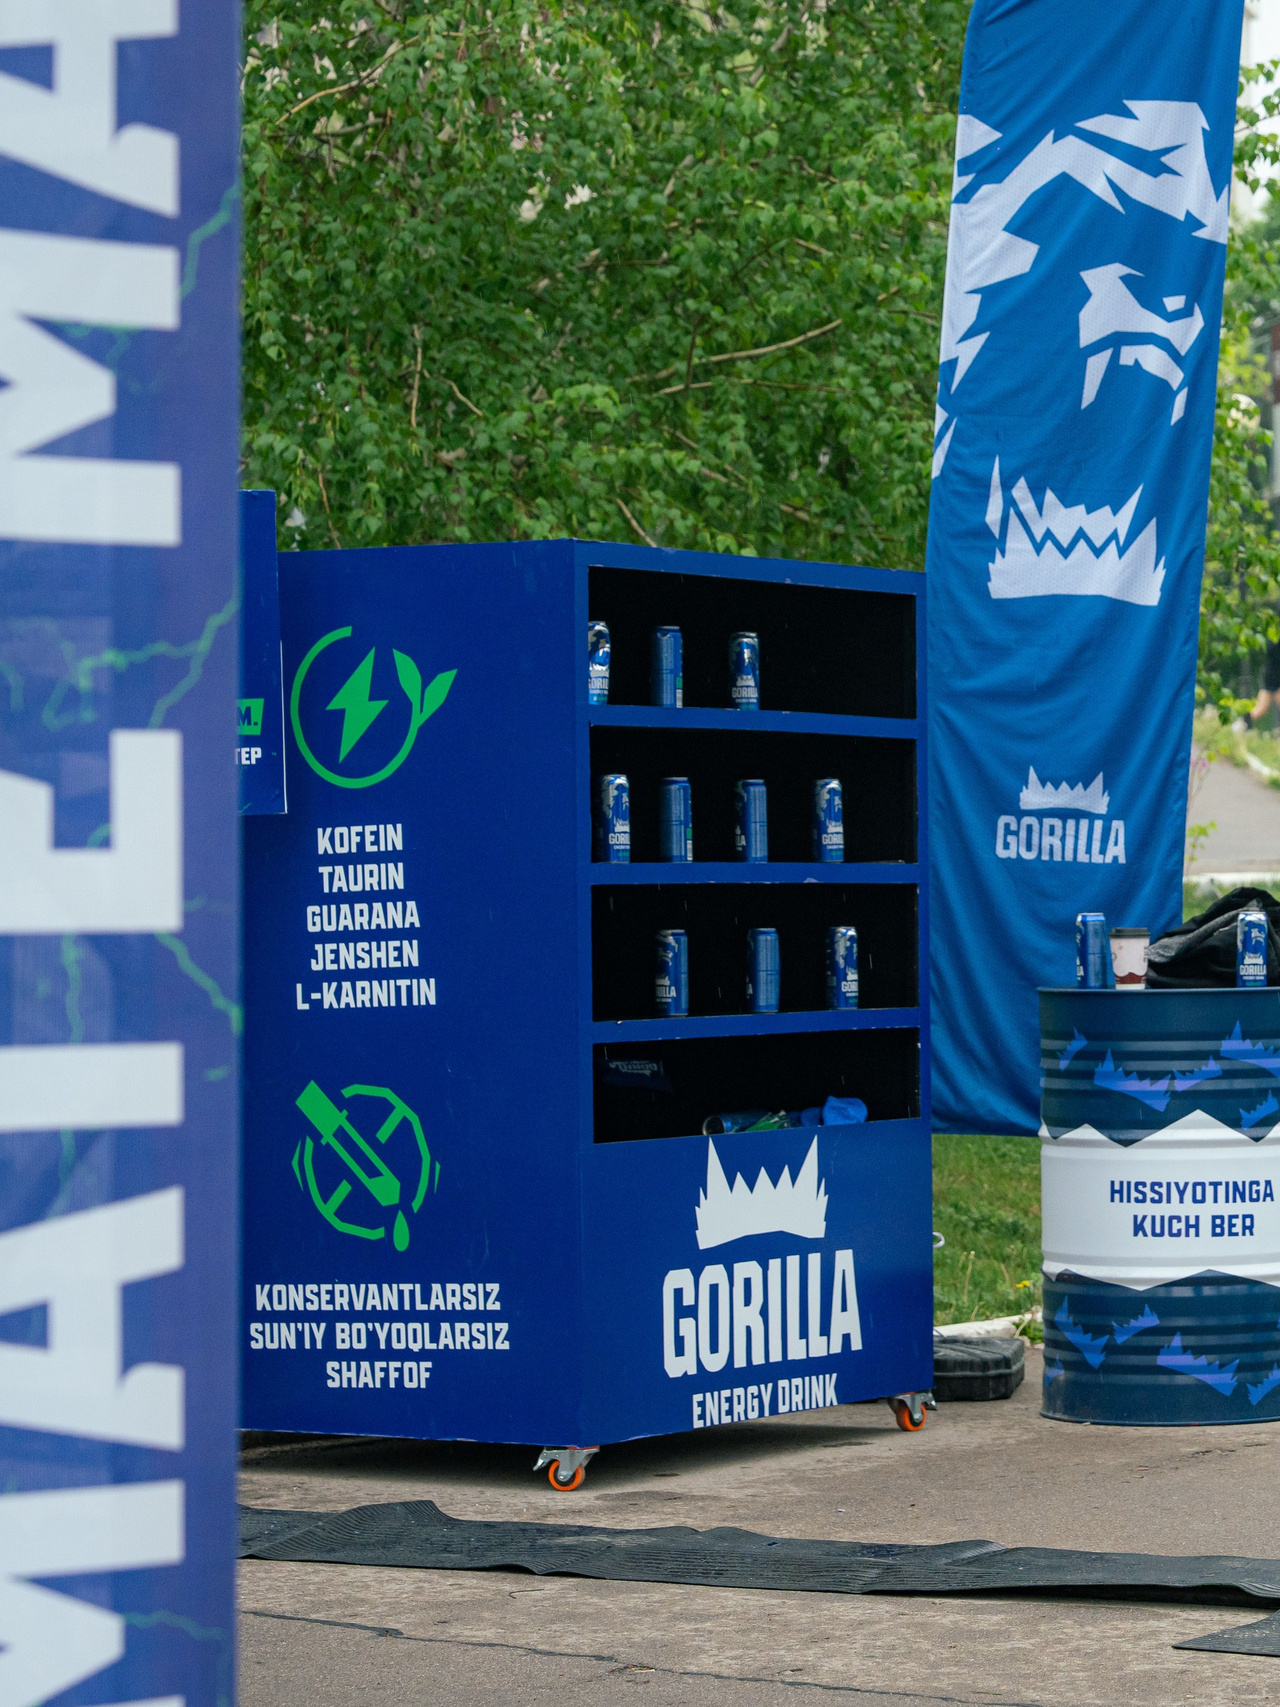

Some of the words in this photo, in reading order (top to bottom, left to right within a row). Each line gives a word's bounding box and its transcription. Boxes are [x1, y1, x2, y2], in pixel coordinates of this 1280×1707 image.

[317, 823, 403, 855] KOFEIN
[995, 815, 1126, 864] GORILLA
[318, 862, 404, 893] TAURIN
[306, 900, 421, 933] GUARANA
[310, 939, 420, 971] JENSHEN
[1239, 964, 1267, 975] GORILLA
[296, 978, 436, 1010] L-KARNITIN
[1110, 1179, 1274, 1204] HISSIYOTINGA
[1132, 1214, 1200, 1238] KUCH
[1211, 1213, 1255, 1237] BER
[255, 1283, 501, 1311] KONSERVANTLARSIZ
[662, 1249, 863, 1378] GORILLA
[249, 1322, 327, 1350] SUN'IY
[336, 1322, 510, 1352] BO'YOQLARSIZ
[326, 1361, 433, 1389] SHAFFOF
[692, 1382, 773, 1429] ENERGY
[777, 1373, 839, 1414] DRINK
